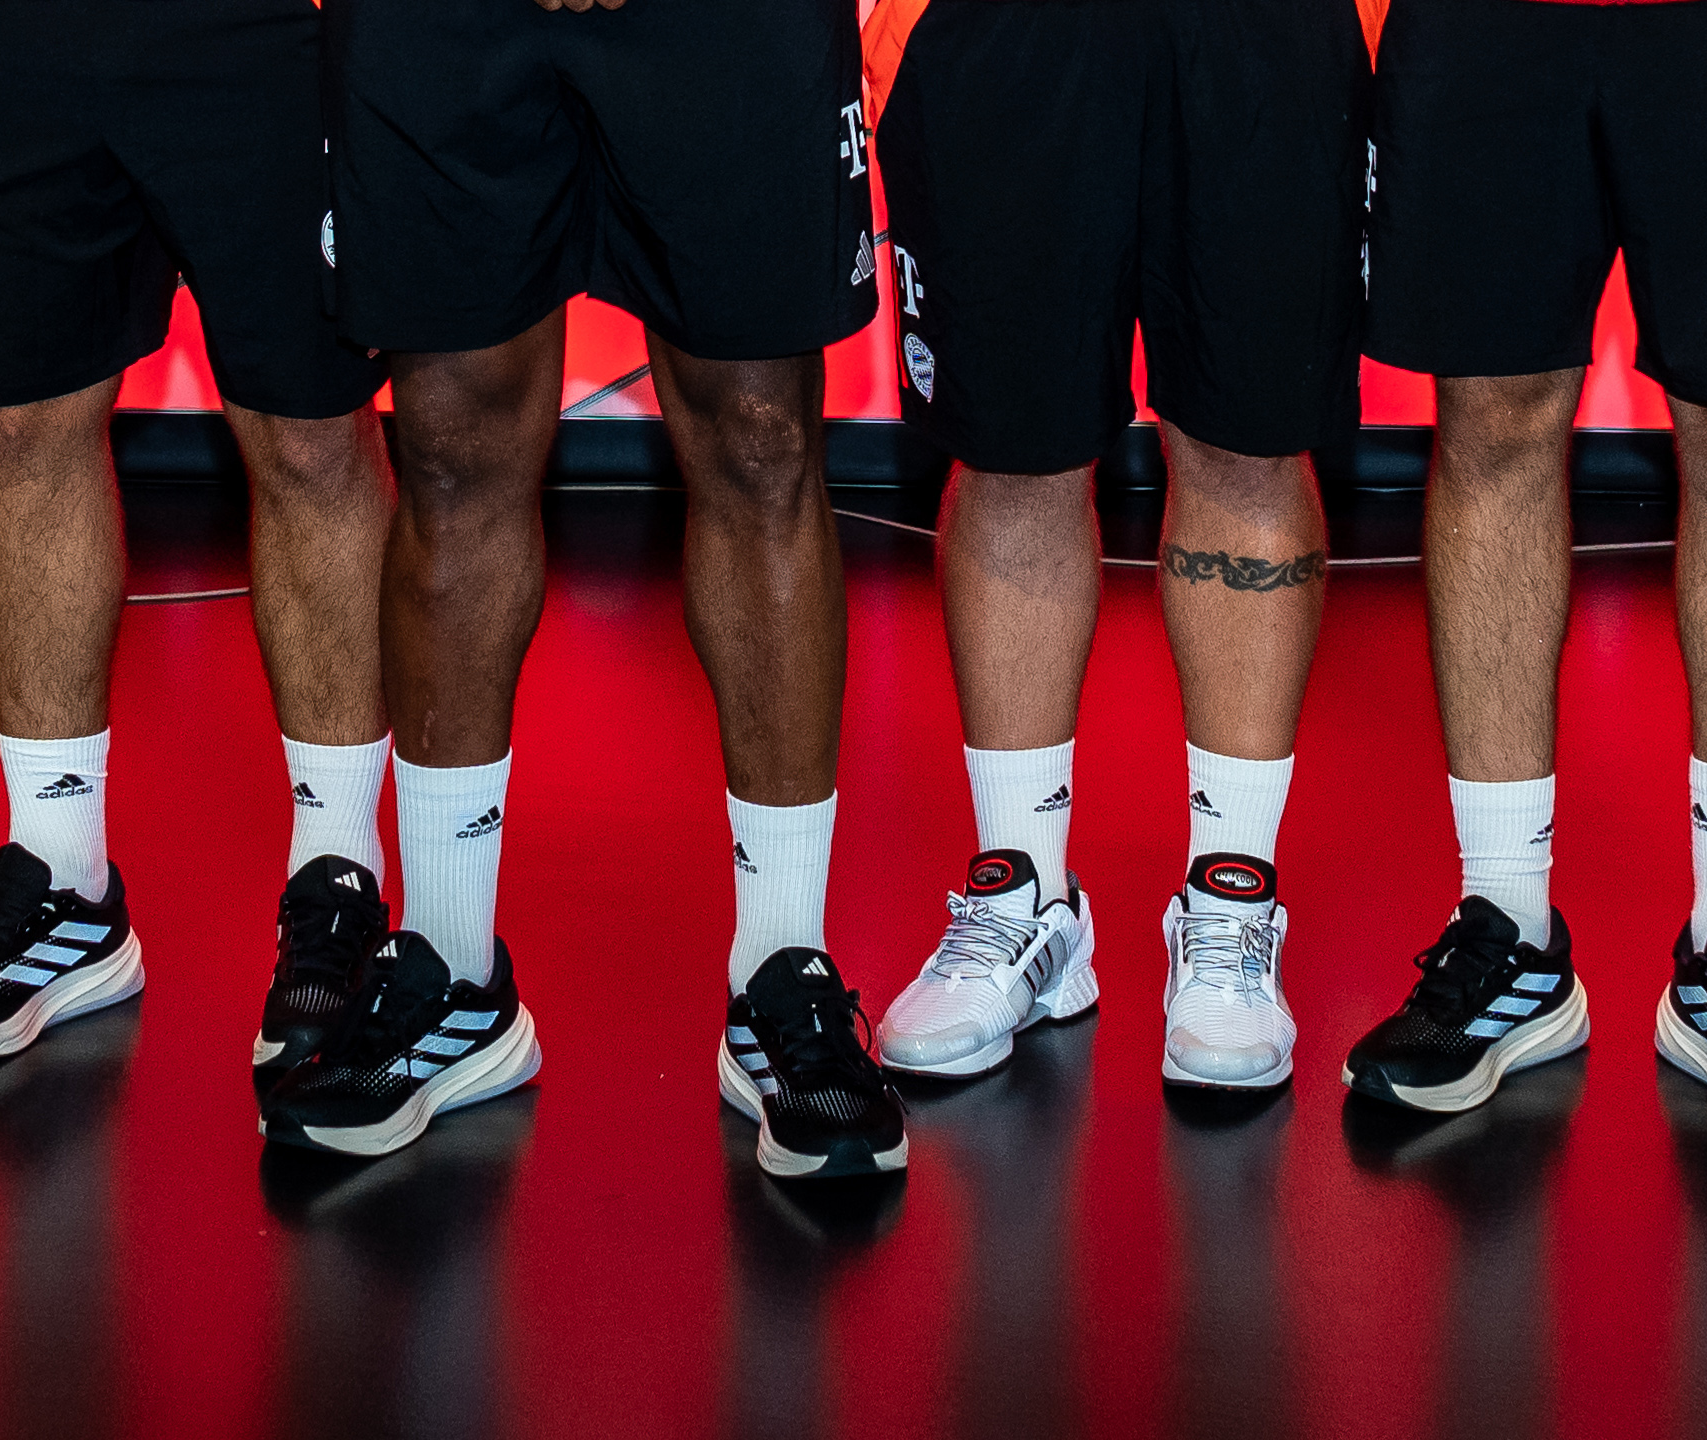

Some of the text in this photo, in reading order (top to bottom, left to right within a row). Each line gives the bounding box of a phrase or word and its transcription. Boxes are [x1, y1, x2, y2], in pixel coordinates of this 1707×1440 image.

[36, 785, 93, 799] adidas
[1034, 798, 1072, 812] adida
[456, 817, 503, 838] adida
